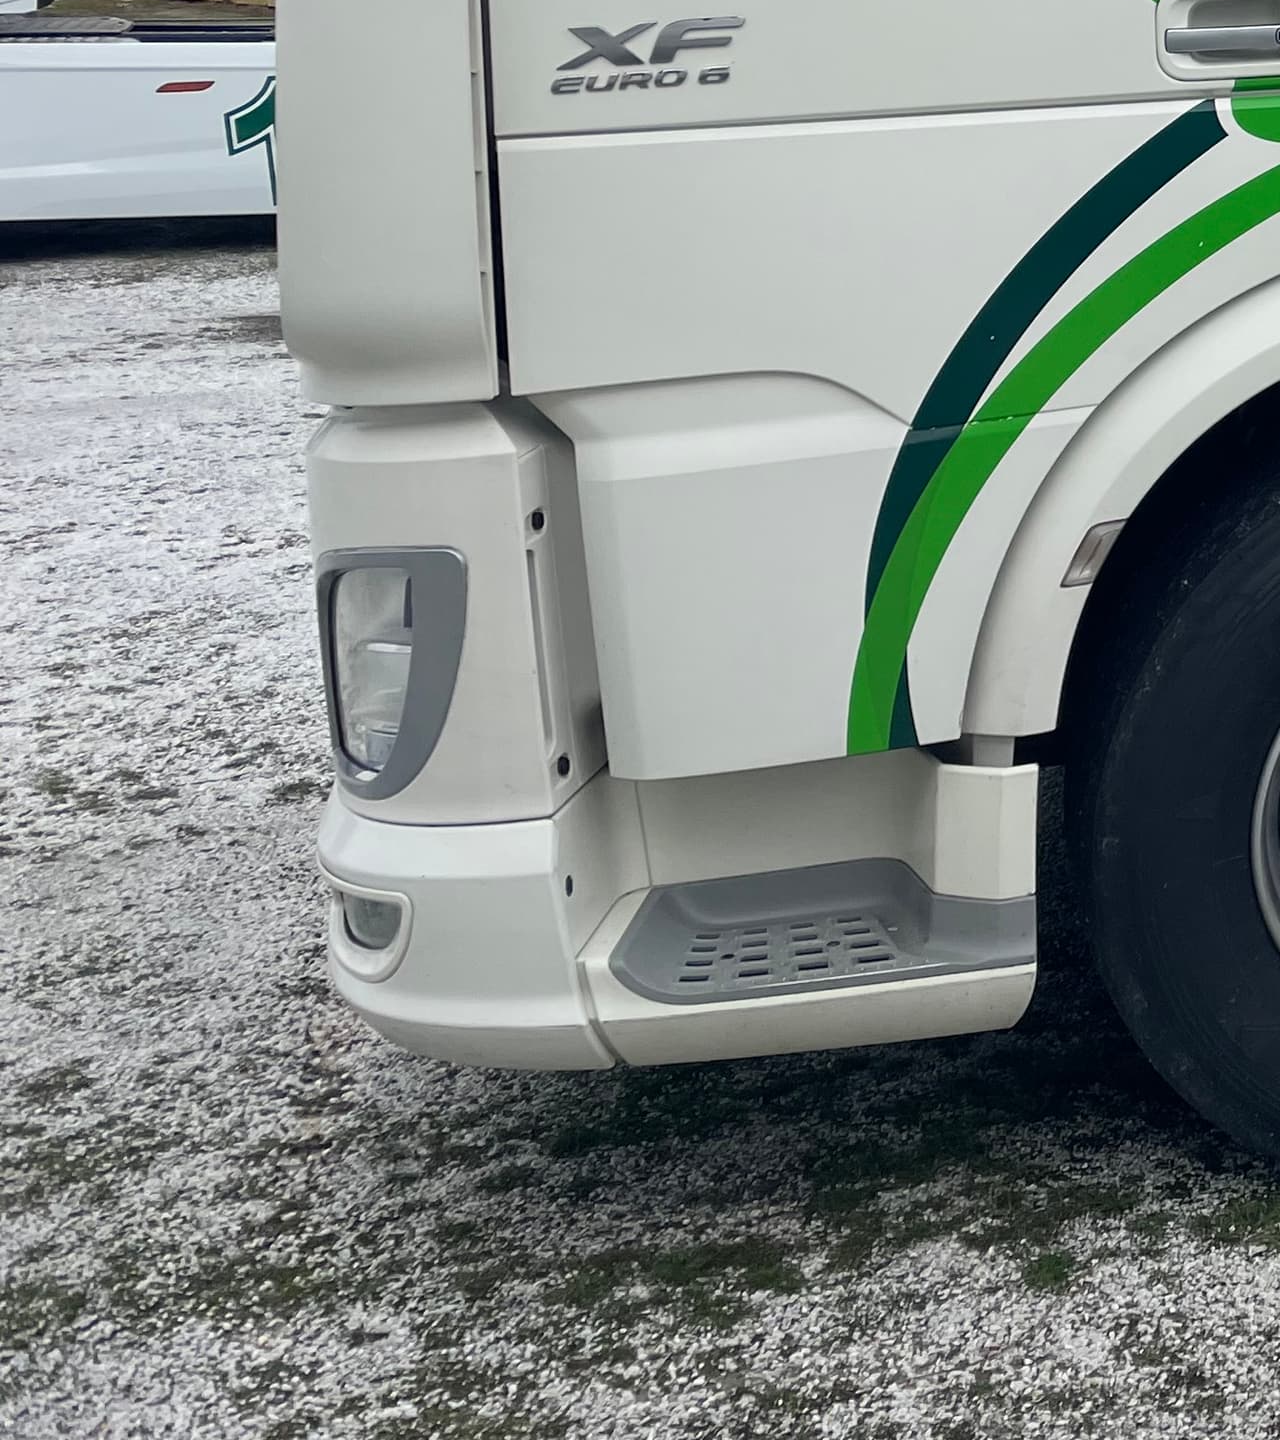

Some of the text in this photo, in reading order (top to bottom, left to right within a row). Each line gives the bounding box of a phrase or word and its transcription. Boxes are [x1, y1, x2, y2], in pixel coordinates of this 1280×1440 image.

[556, 15, 746, 71] XF
[550, 66, 731, 95] EURO 6
